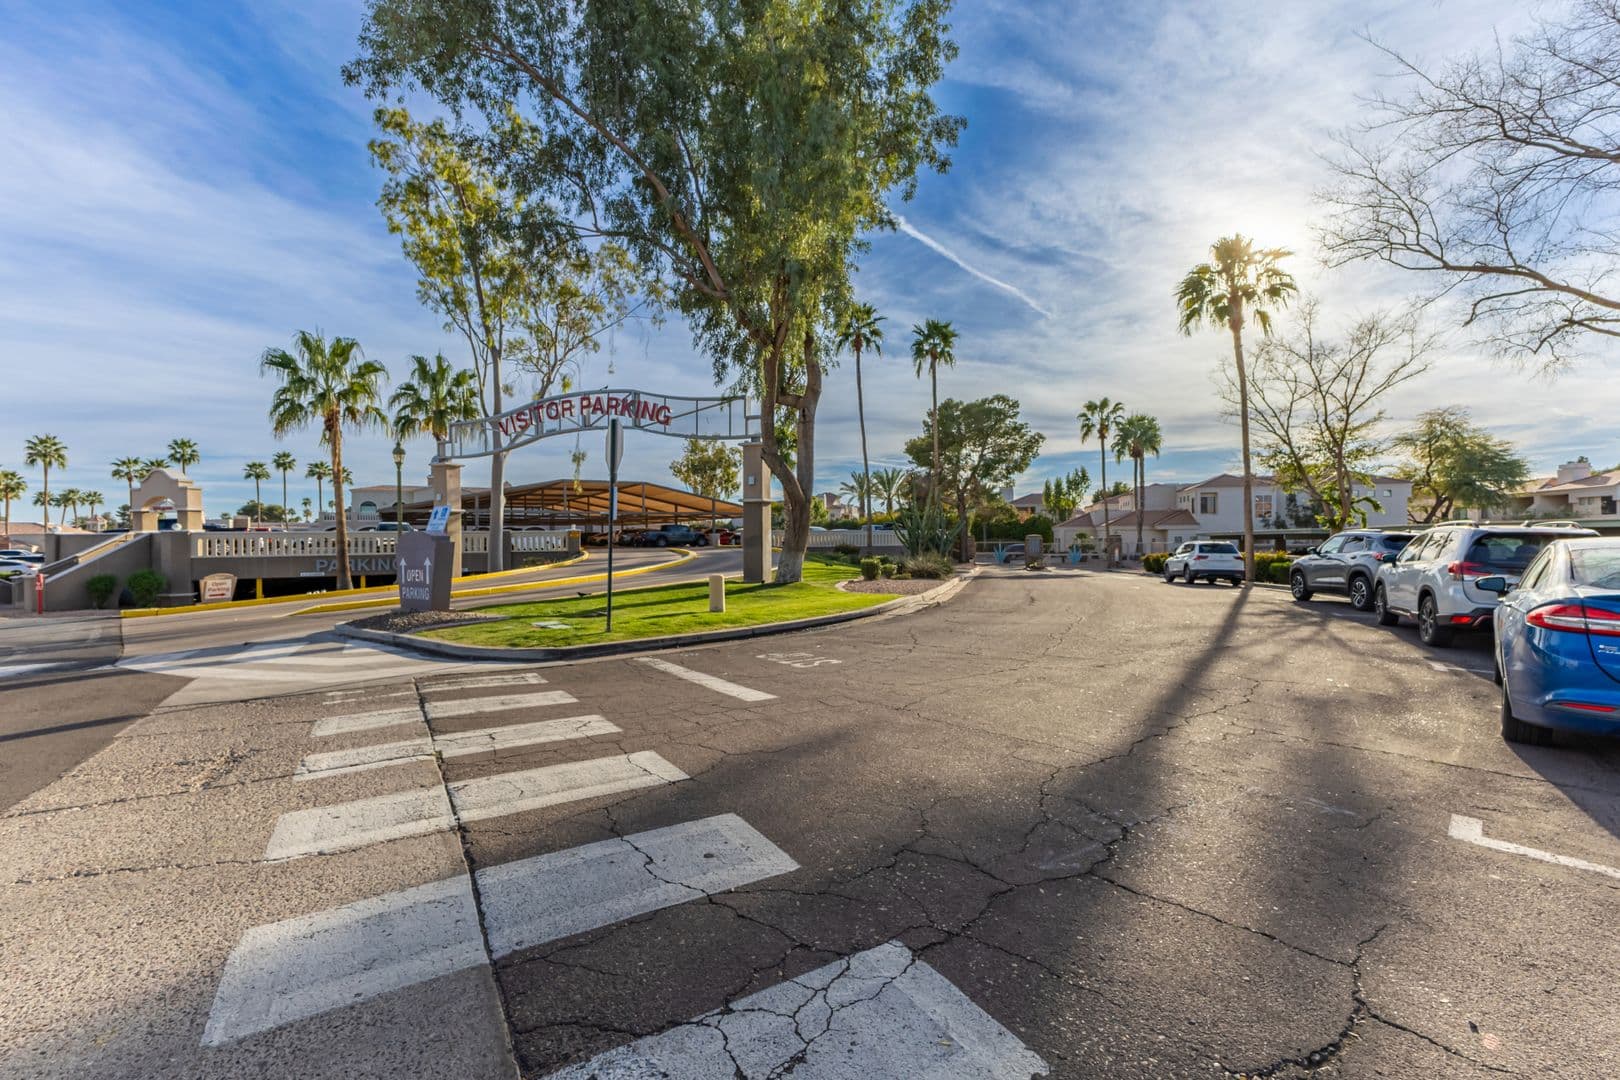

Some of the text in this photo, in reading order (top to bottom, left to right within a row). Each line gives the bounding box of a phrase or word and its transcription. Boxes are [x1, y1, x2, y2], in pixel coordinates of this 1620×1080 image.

[499, 396, 672, 436] VISITOR PARKING
[407, 569, 424, 582] OPEN
[402, 586, 430, 600] PARKING
